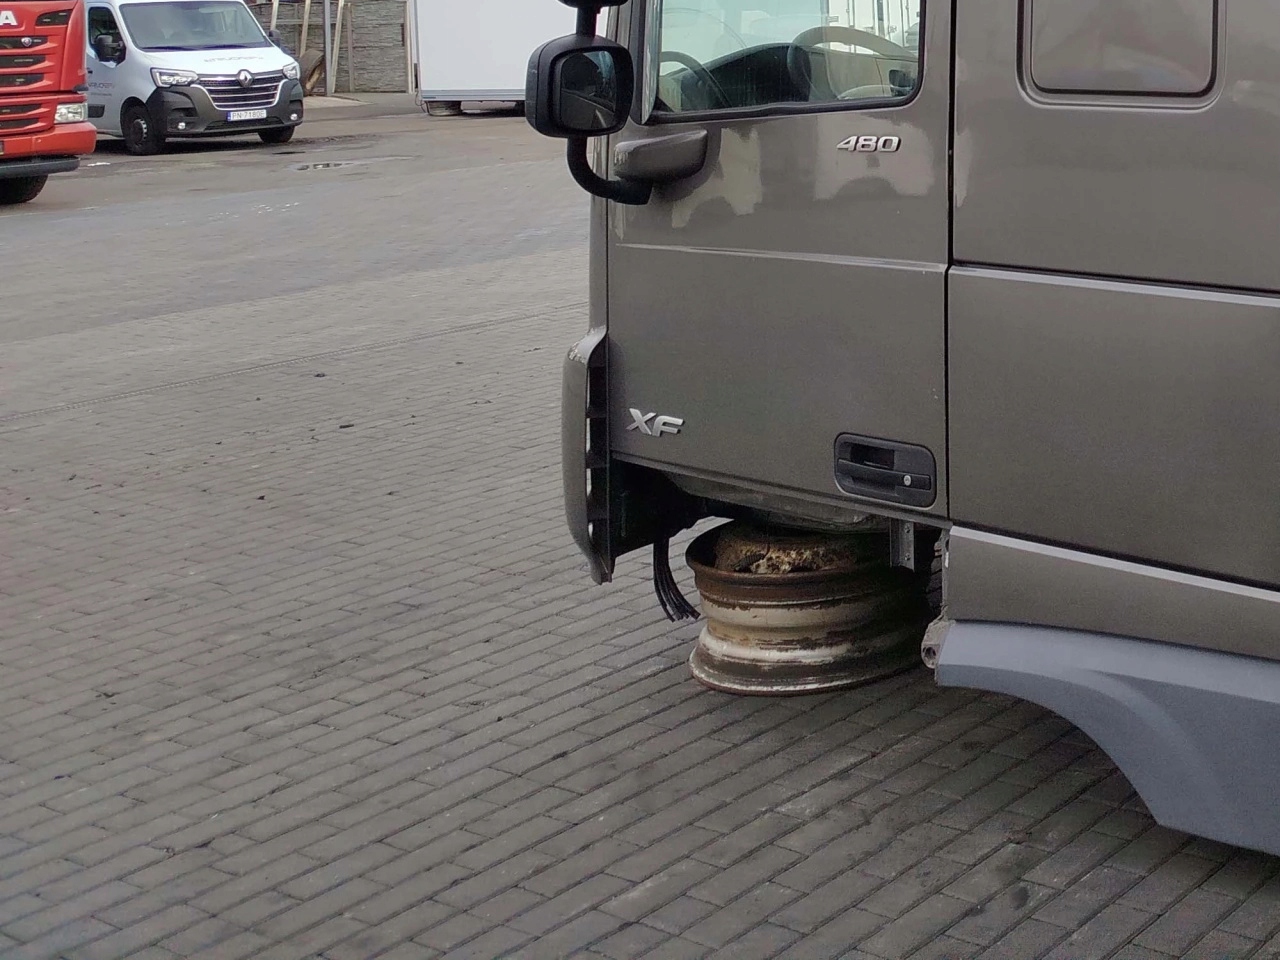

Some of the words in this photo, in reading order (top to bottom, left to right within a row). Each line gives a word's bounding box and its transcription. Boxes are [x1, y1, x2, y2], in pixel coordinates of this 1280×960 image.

[232, 112, 242, 120] PN
[836, 135, 901, 152] 480
[625, 407, 685, 437] XF
